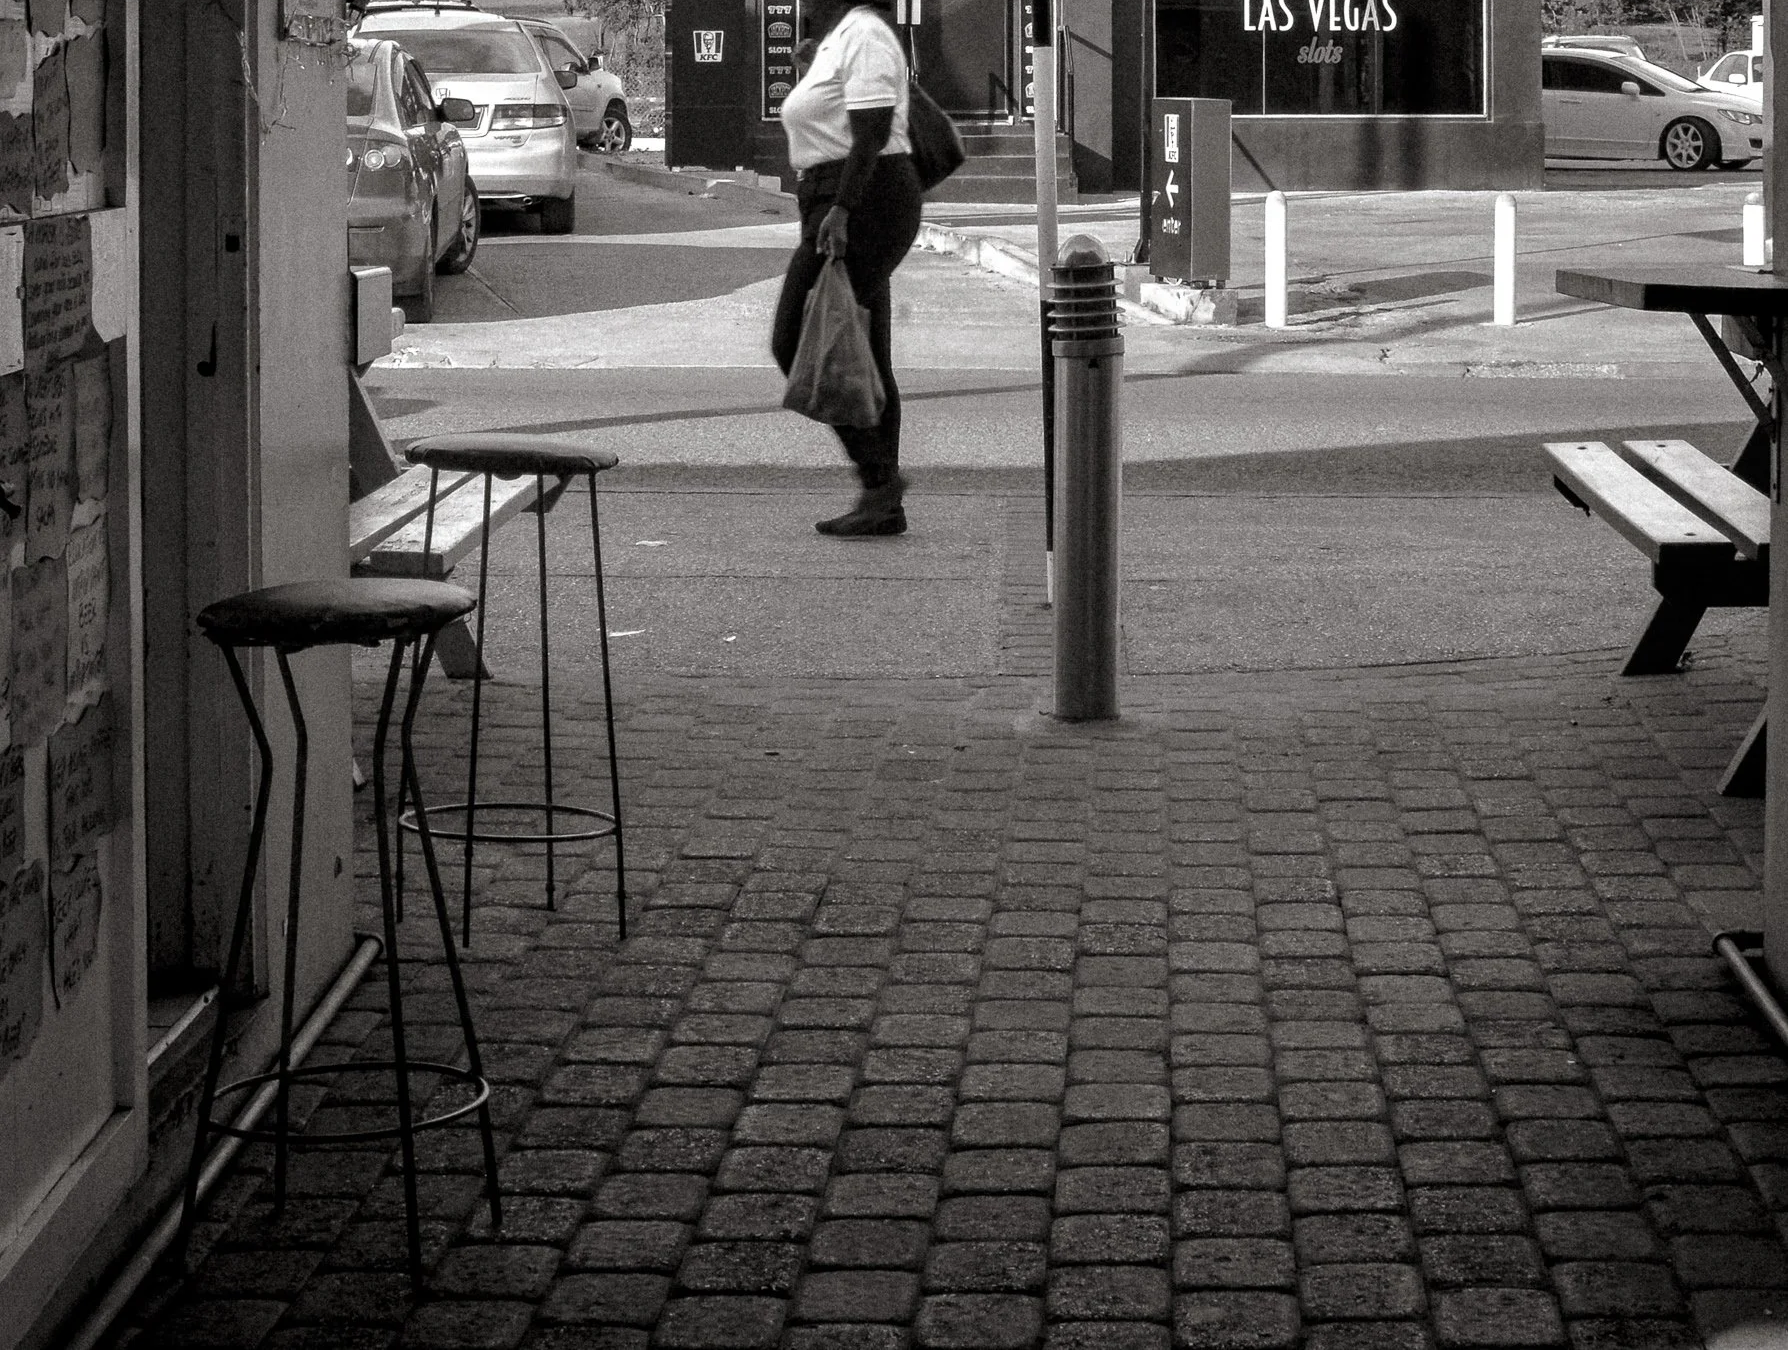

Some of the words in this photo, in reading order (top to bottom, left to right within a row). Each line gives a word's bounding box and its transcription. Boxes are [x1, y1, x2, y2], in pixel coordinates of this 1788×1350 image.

[768, 5, 792, 15] 777
[768, 46, 793, 54] SLOTS
[1297, 37, 1343, 64] slots
[768, 66, 792, 75] 777
[768, 107, 783, 115] SLO
[1161, 216, 1182, 235] enter
